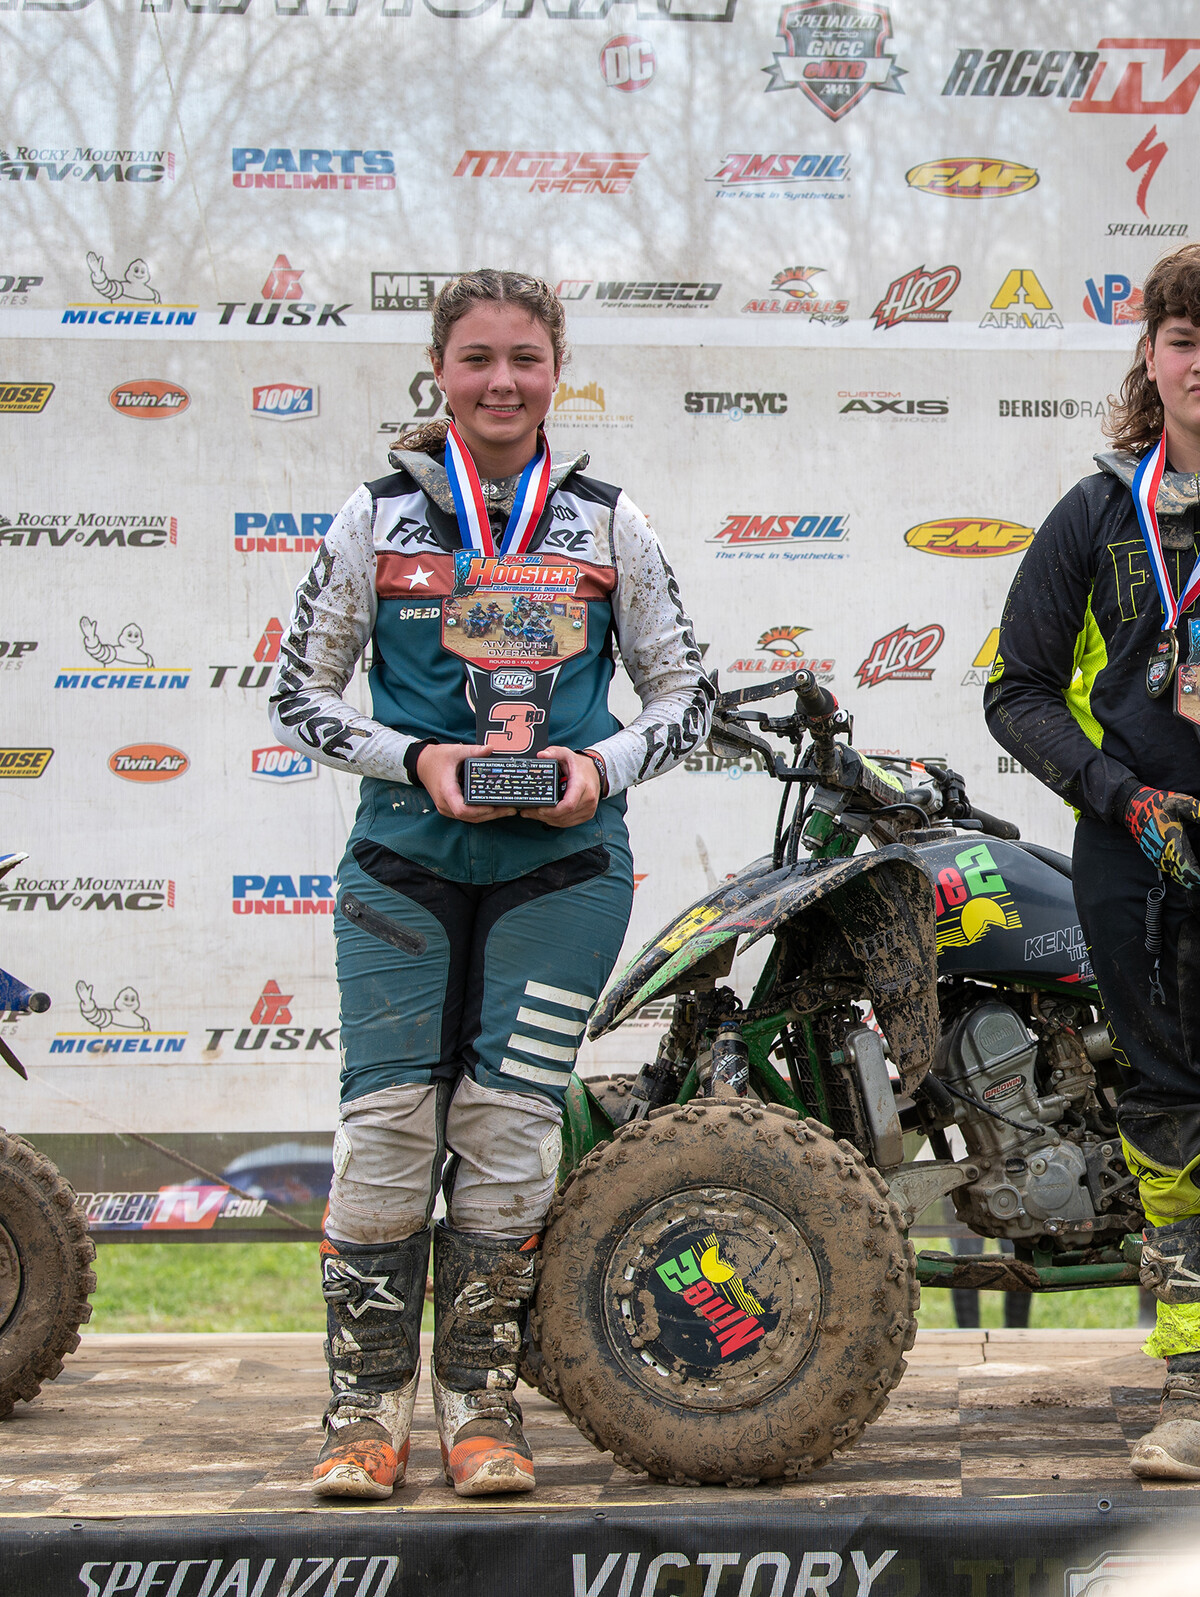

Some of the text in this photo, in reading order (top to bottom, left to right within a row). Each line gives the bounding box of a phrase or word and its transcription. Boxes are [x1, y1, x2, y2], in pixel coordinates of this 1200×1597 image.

[791, 14, 880, 30] SPECIALIZED
[806, 41, 864, 57] GNCC
[605, 42, 656, 88] DC
[15, 146, 165, 164] ROCKY MOUNTAIN
[232, 147, 396, 173] PARTS
[453, 151, 651, 179] MOOSE
[712, 153, 850, 183] AMSOIL
[232, 173, 396, 191] UNLIMITED
[909, 163, 1038, 189] FMF
[528, 179, 634, 194] RACING
[1105, 223, 1188, 236] SPECIALIZED
[743, 298, 849, 314] ALL BALLS
[1085, 273, 1132, 325] VP
[61, 309, 197, 326] MICHELIN
[217, 302, 354, 327] TUSK
[979, 312, 1064, 329] ARMA
[115, 391, 186, 407] Twin Air
[255, 388, 313, 411] 100%
[684, 391, 788, 414] STACYC
[838, 400, 949, 415] AXIS
[17, 512, 167, 527] ROCKY MOUNTAIN
[712, 514, 849, 543] AMSOIL
[905, 523, 1034, 549] FMF
[501, 555, 543, 565] AMSOIL
[782, 551, 844, 561] Synthetics
[464, 557, 579, 586] HOOSIER
[400, 607, 441, 621] SPEED
[481, 641, 549, 649] ATV YOUTH
[487, 649, 543, 657] OVERALL
[726, 659, 836, 674] ALL BALLS
[54, 674, 191, 690] MICHELIN
[495, 675, 533, 686] GNCC
[113, 755, 186, 771] Twin Air
[255, 750, 309, 774] 100%
[12, 877, 165, 891] ROCKY MOUNTAIN
[49, 1038, 187, 1054] MICHELIN
[204, 1028, 340, 1051] TUSK
[984, 1076, 1022, 1099] BALDWIN
[78, 1555, 401, 1597] SPECIALIZED
[571, 1550, 899, 1597] VICTORY
